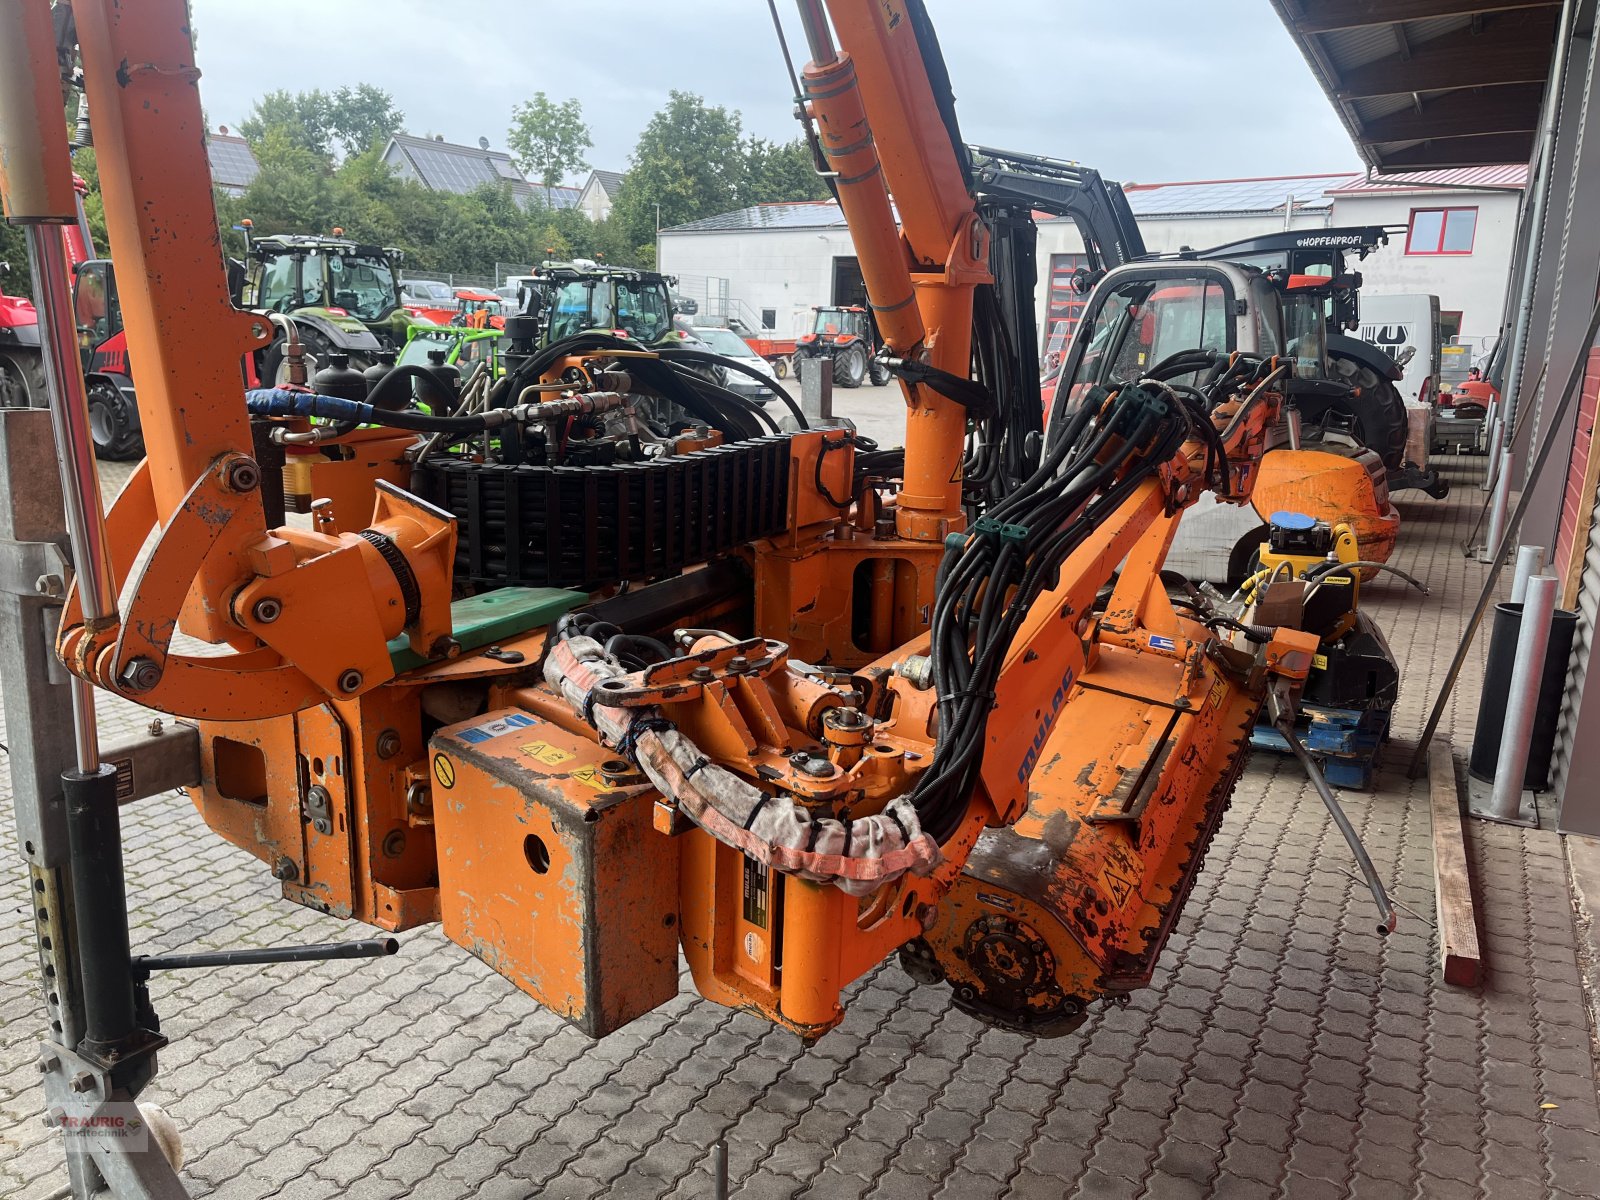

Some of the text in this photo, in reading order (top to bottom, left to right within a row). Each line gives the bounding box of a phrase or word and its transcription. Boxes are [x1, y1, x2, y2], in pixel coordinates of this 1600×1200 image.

[1302, 235, 1362, 247] HOPFENPROFI
[332, 261, 341, 270] 40
[620, 287, 626, 295] 50
[1017, 665, 1073, 785] MULAG
